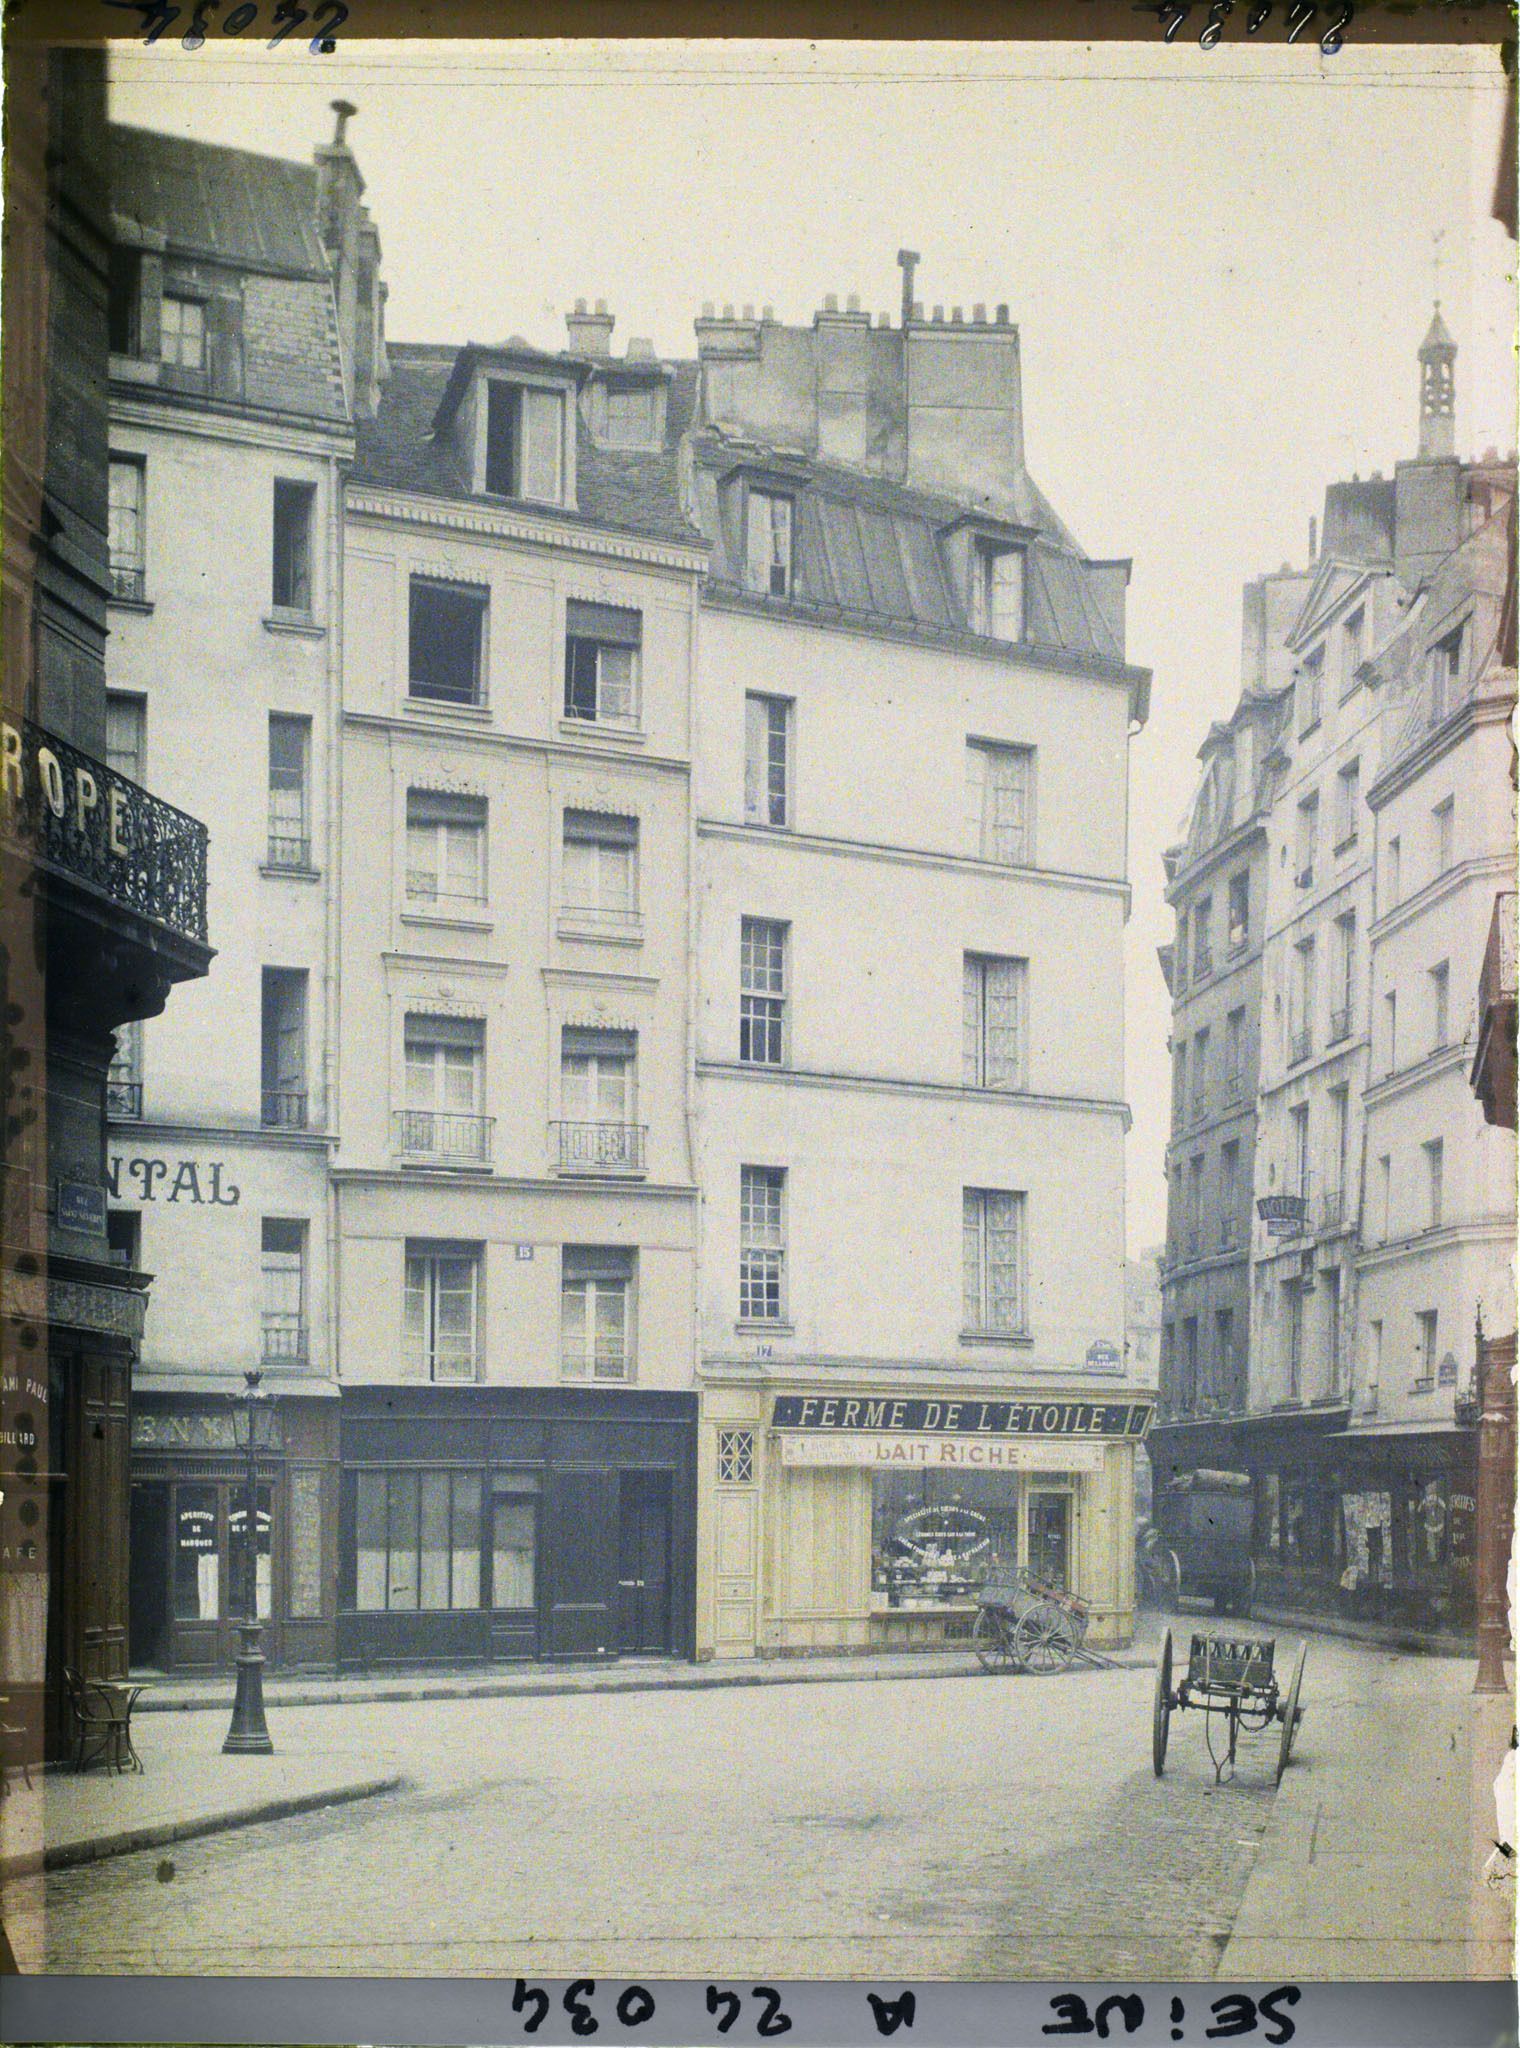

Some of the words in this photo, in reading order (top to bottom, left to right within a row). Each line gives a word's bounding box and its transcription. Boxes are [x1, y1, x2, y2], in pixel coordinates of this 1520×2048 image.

[1, 722, 129, 858] ROPE
[519, 1246, 530, 1258] 15
[757, 1345, 772, 1357] 17
[26, 1378, 47, 1404] PAUL
[798, 1398, 908, 1428] FERME
[923, 1402, 963, 1430] DE
[875, 1442, 929, 1462] LAIT
[939, 1443, 1019, 1465] RICHE
[867, 1990, 916, 2036] A
